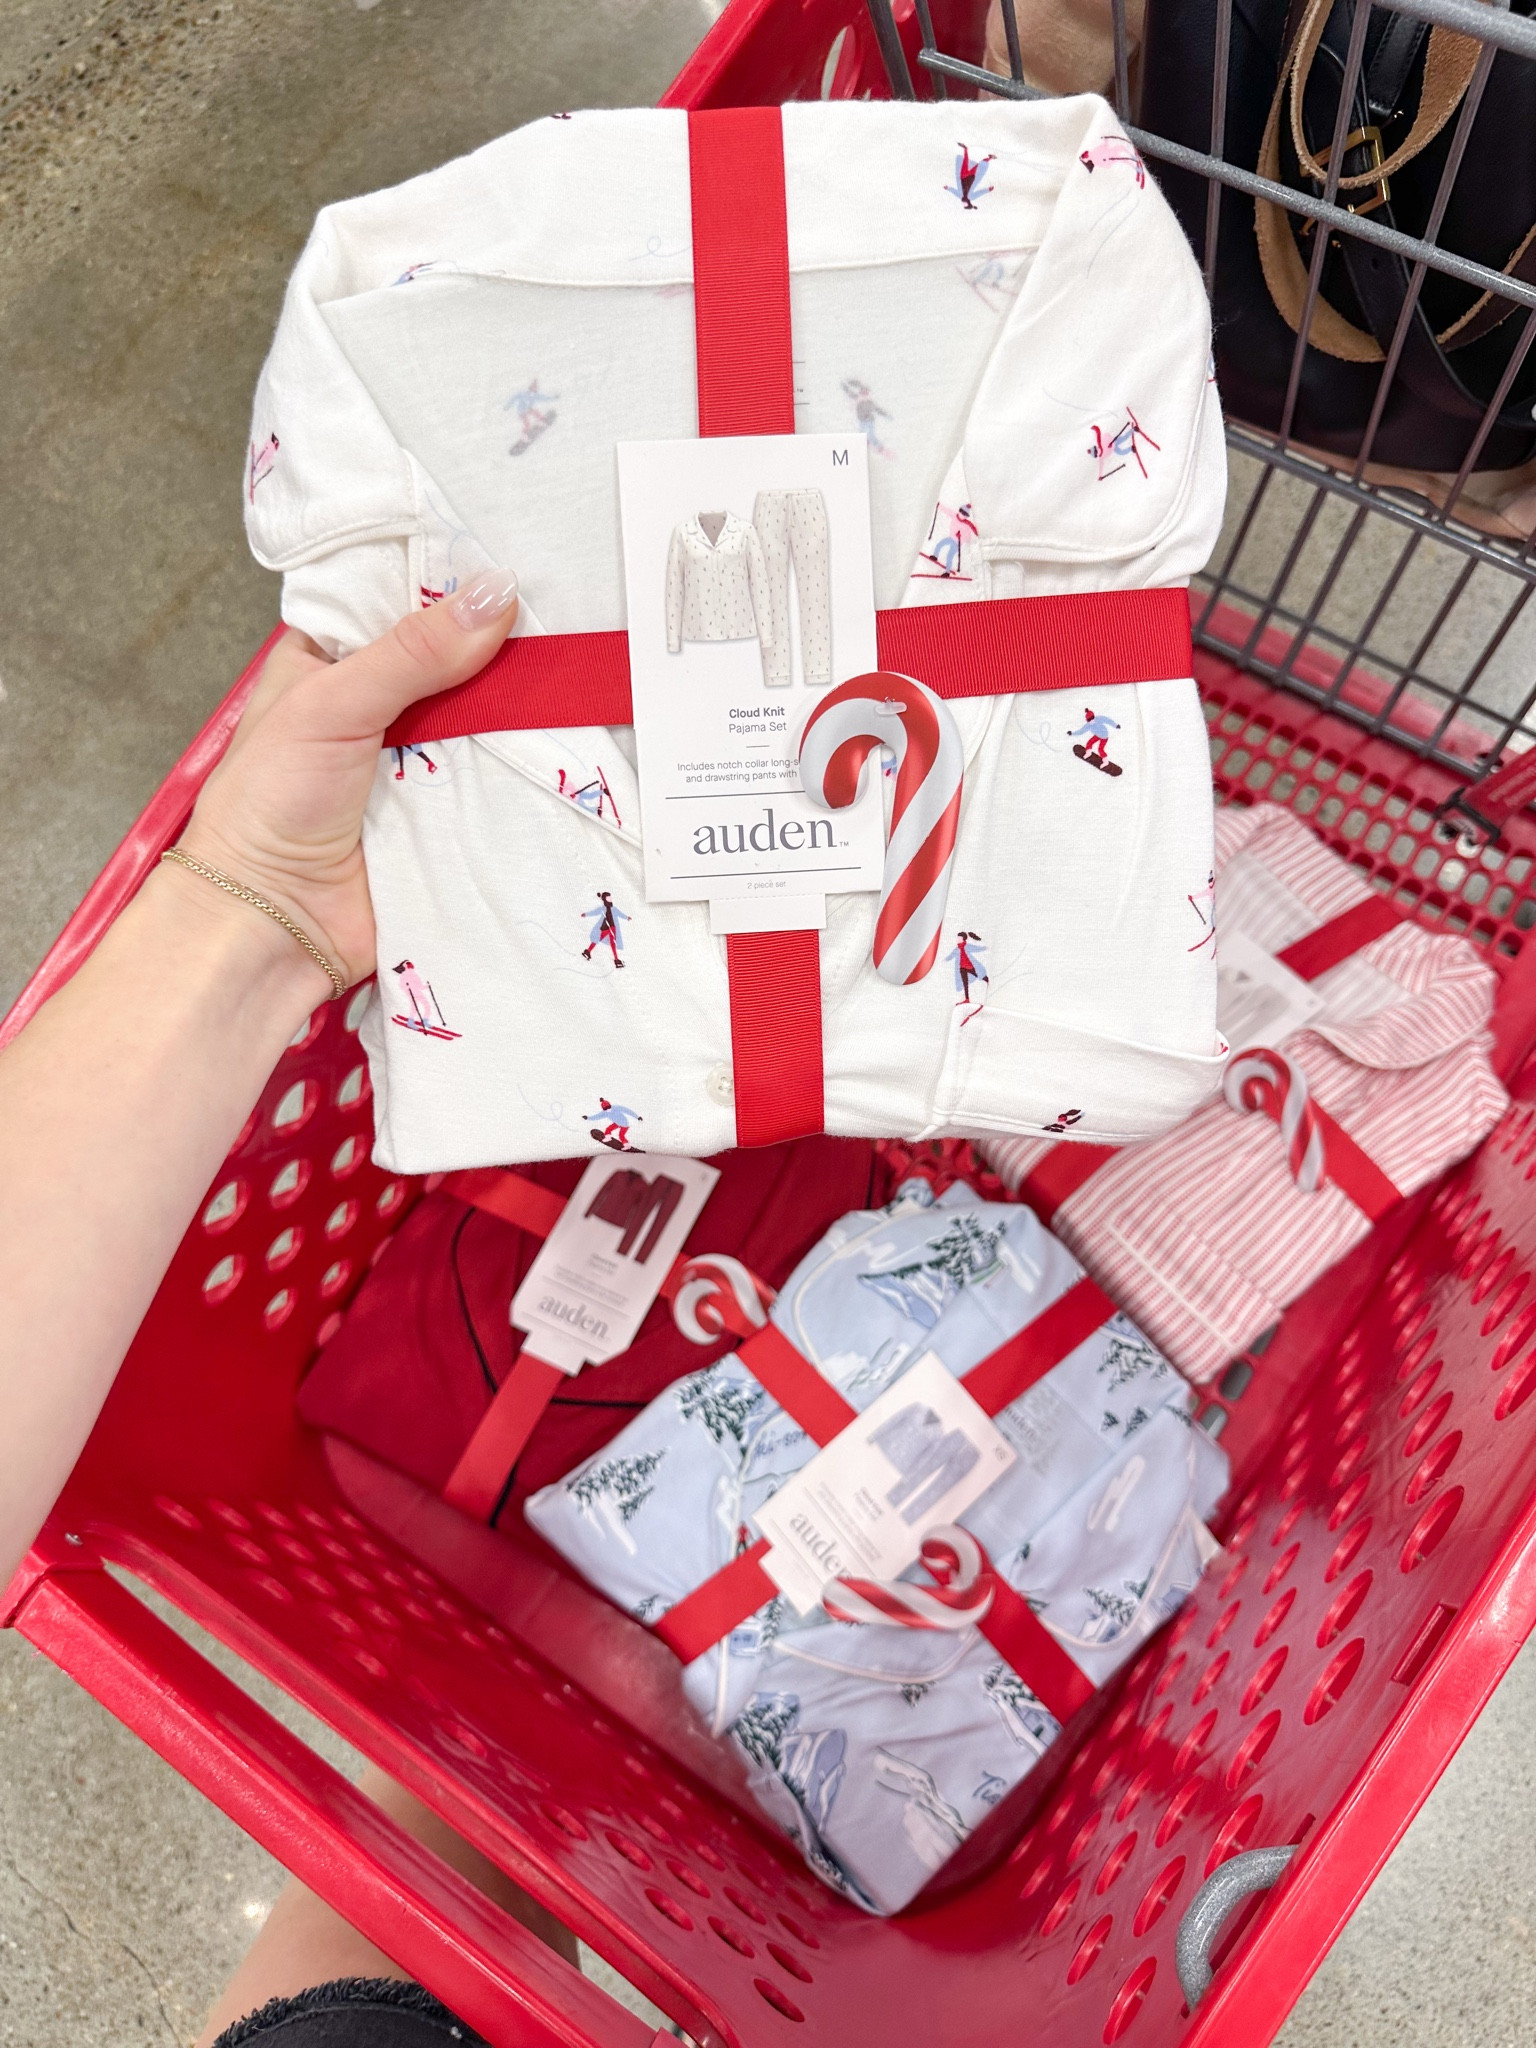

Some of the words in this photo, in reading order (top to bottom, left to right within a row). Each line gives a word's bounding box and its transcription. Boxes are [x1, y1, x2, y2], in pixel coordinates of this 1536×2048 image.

[832, 449, 849, 466] M
[729, 707, 760, 718] Cloud
[763, 706, 785, 717] Knit
[729, 723, 767, 735] Pajama
[769, 721, 787, 732] Set
[677, 761, 715, 772] Includes
[717, 760, 743, 770] notch
[745, 759, 769, 768] collar
[771, 758, 799, 769] long-s
[686, 773, 702, 783] and
[705, 772, 750, 783] drawstring
[752, 771, 777, 782] pants
[778, 769, 798, 778] with
[693, 808, 837, 855] auden
[754, 881, 774, 890] piece
[775, 880, 786, 888] set
[537, 1295, 609, 1338] auden
